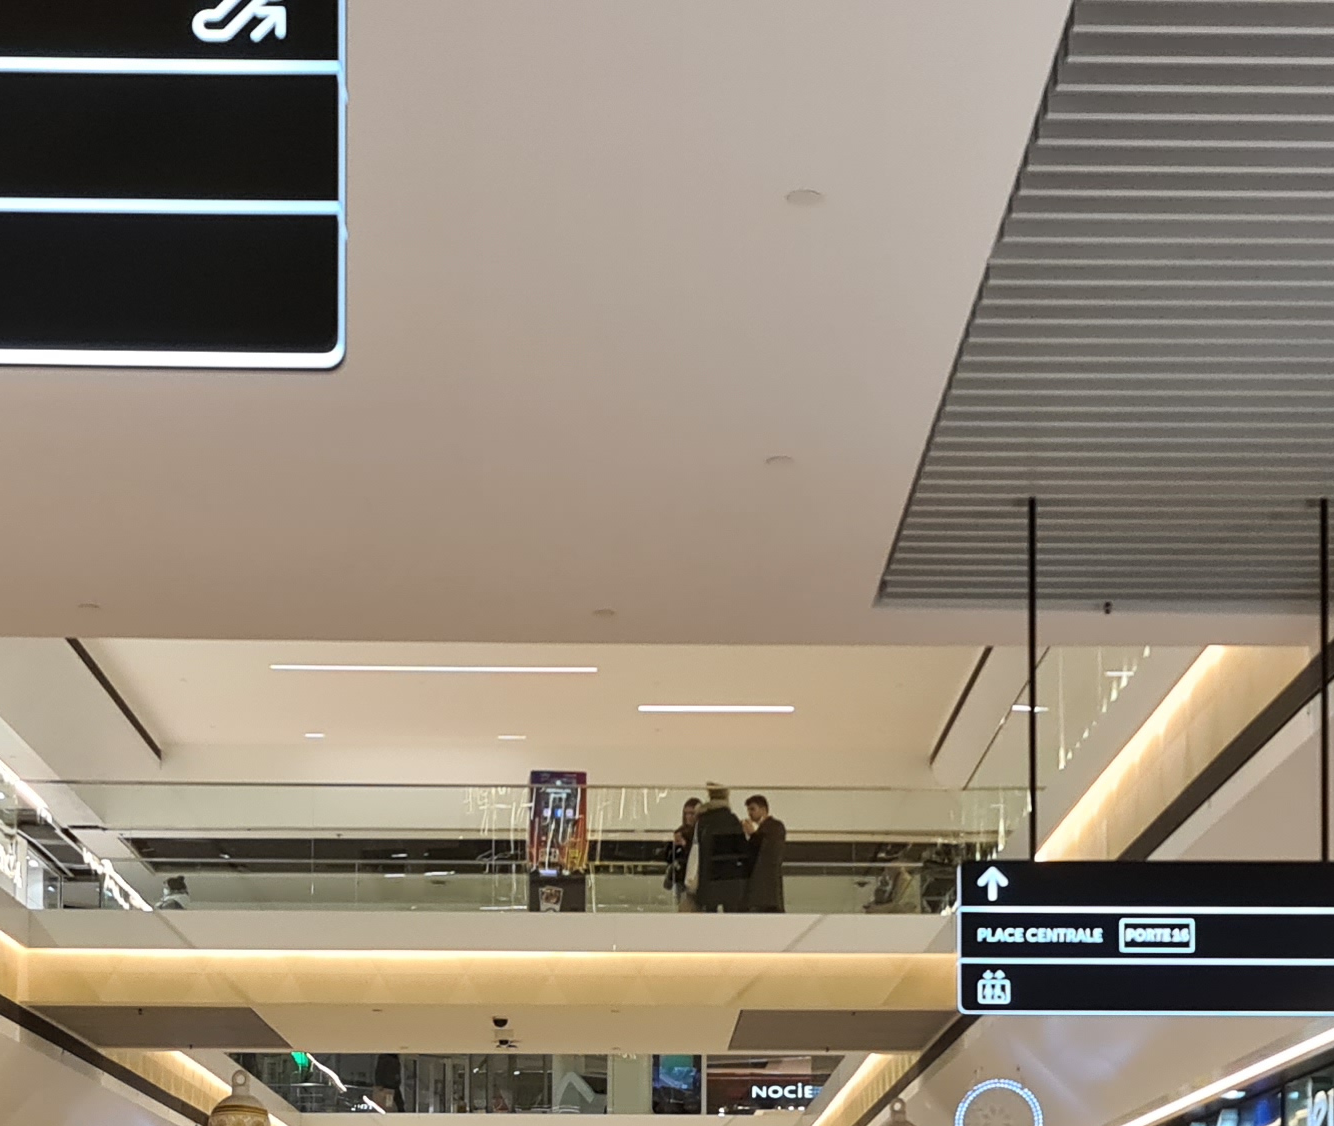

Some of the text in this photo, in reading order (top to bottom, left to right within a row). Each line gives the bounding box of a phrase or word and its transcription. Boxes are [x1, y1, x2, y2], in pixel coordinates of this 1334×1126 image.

[977, 928, 1104, 944] PLACE CENTRALE
[1124, 928, 1171, 942] PORTE
